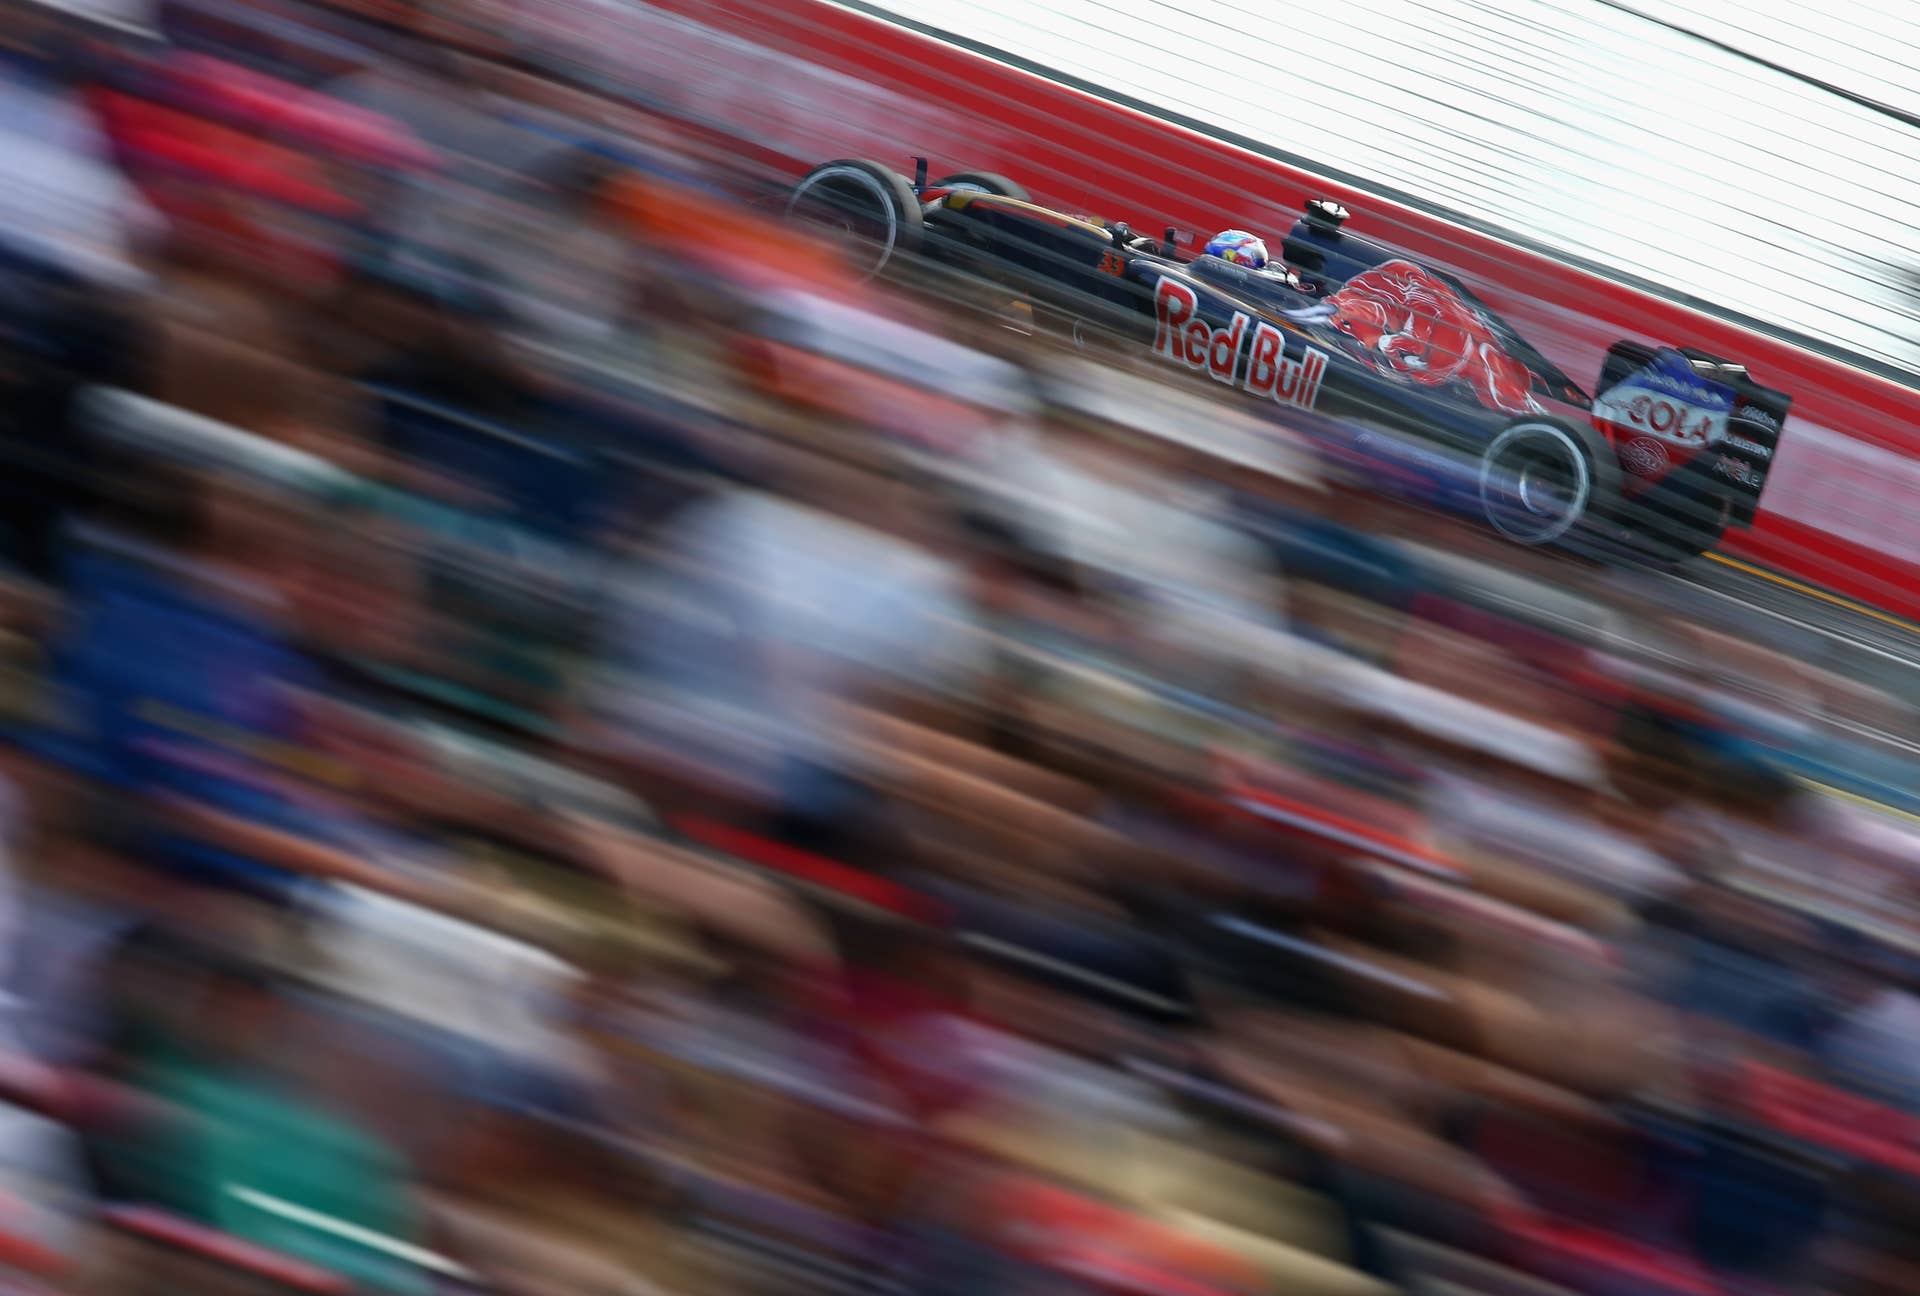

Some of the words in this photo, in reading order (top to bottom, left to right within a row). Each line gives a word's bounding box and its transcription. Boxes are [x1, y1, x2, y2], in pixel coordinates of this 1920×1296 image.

[1097, 250, 1124, 276] 33
[1153, 276, 1249, 385] Red
[1245, 322, 1329, 410] Bull
[1627, 395, 1712, 447] COLA
